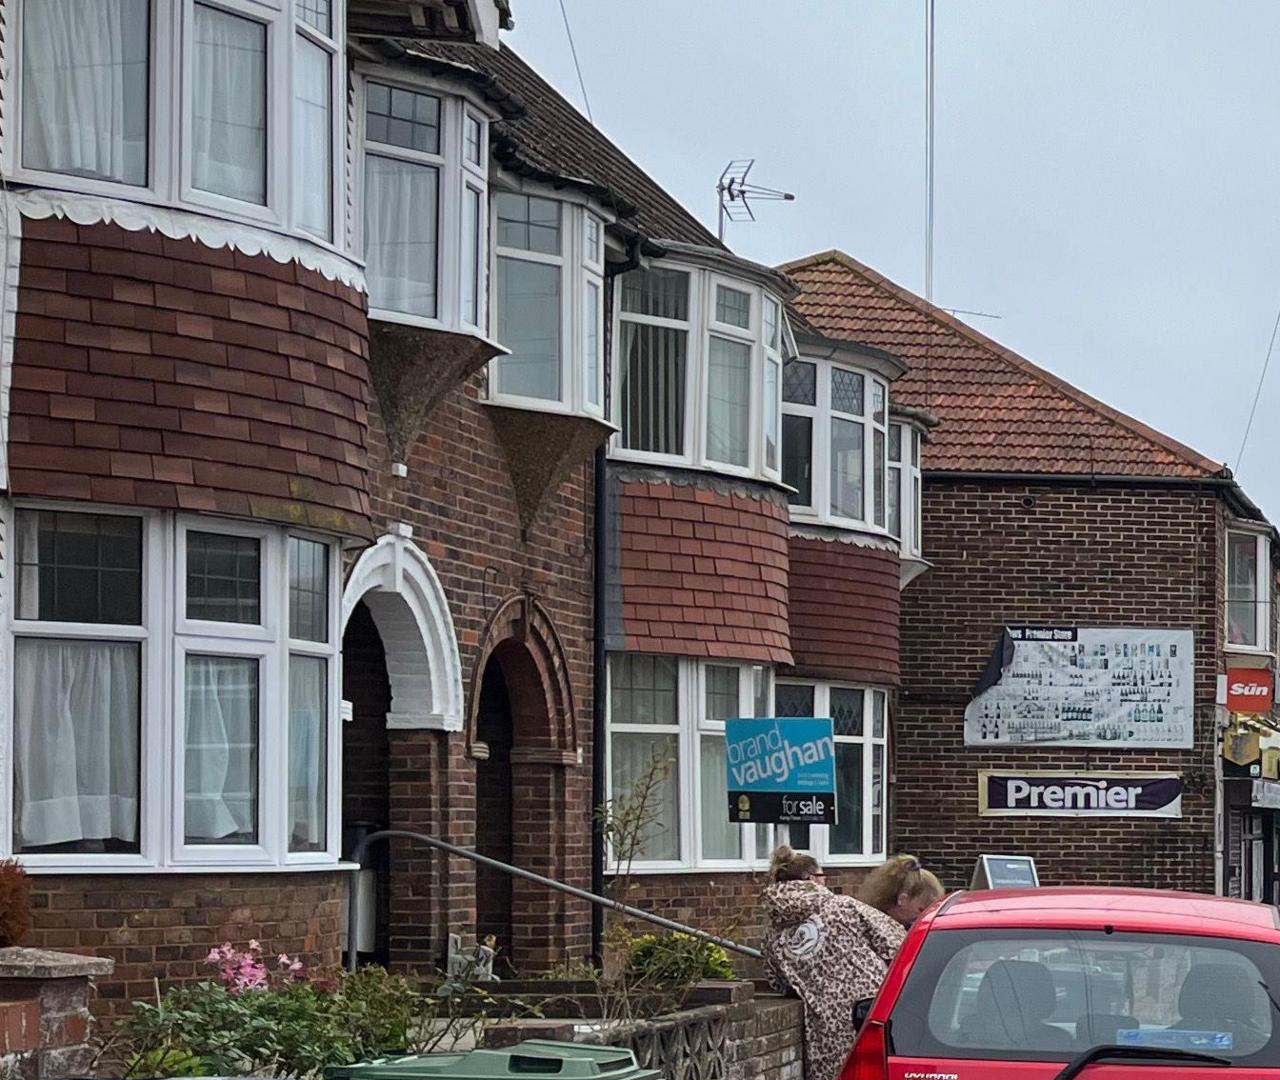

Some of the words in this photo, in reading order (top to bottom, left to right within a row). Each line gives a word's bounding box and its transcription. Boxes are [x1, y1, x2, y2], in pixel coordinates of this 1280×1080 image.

[1025, 628, 1052, 639] Premier
[1053, 629, 1073, 640] Store
[1229, 683, 1268, 696] Sun
[726, 719, 782, 764] brand
[731, 737, 834, 786] vaughan
[782, 795, 798, 815] for
[799, 795, 825, 815] sale
[1006, 780, 1143, 809] Premier
